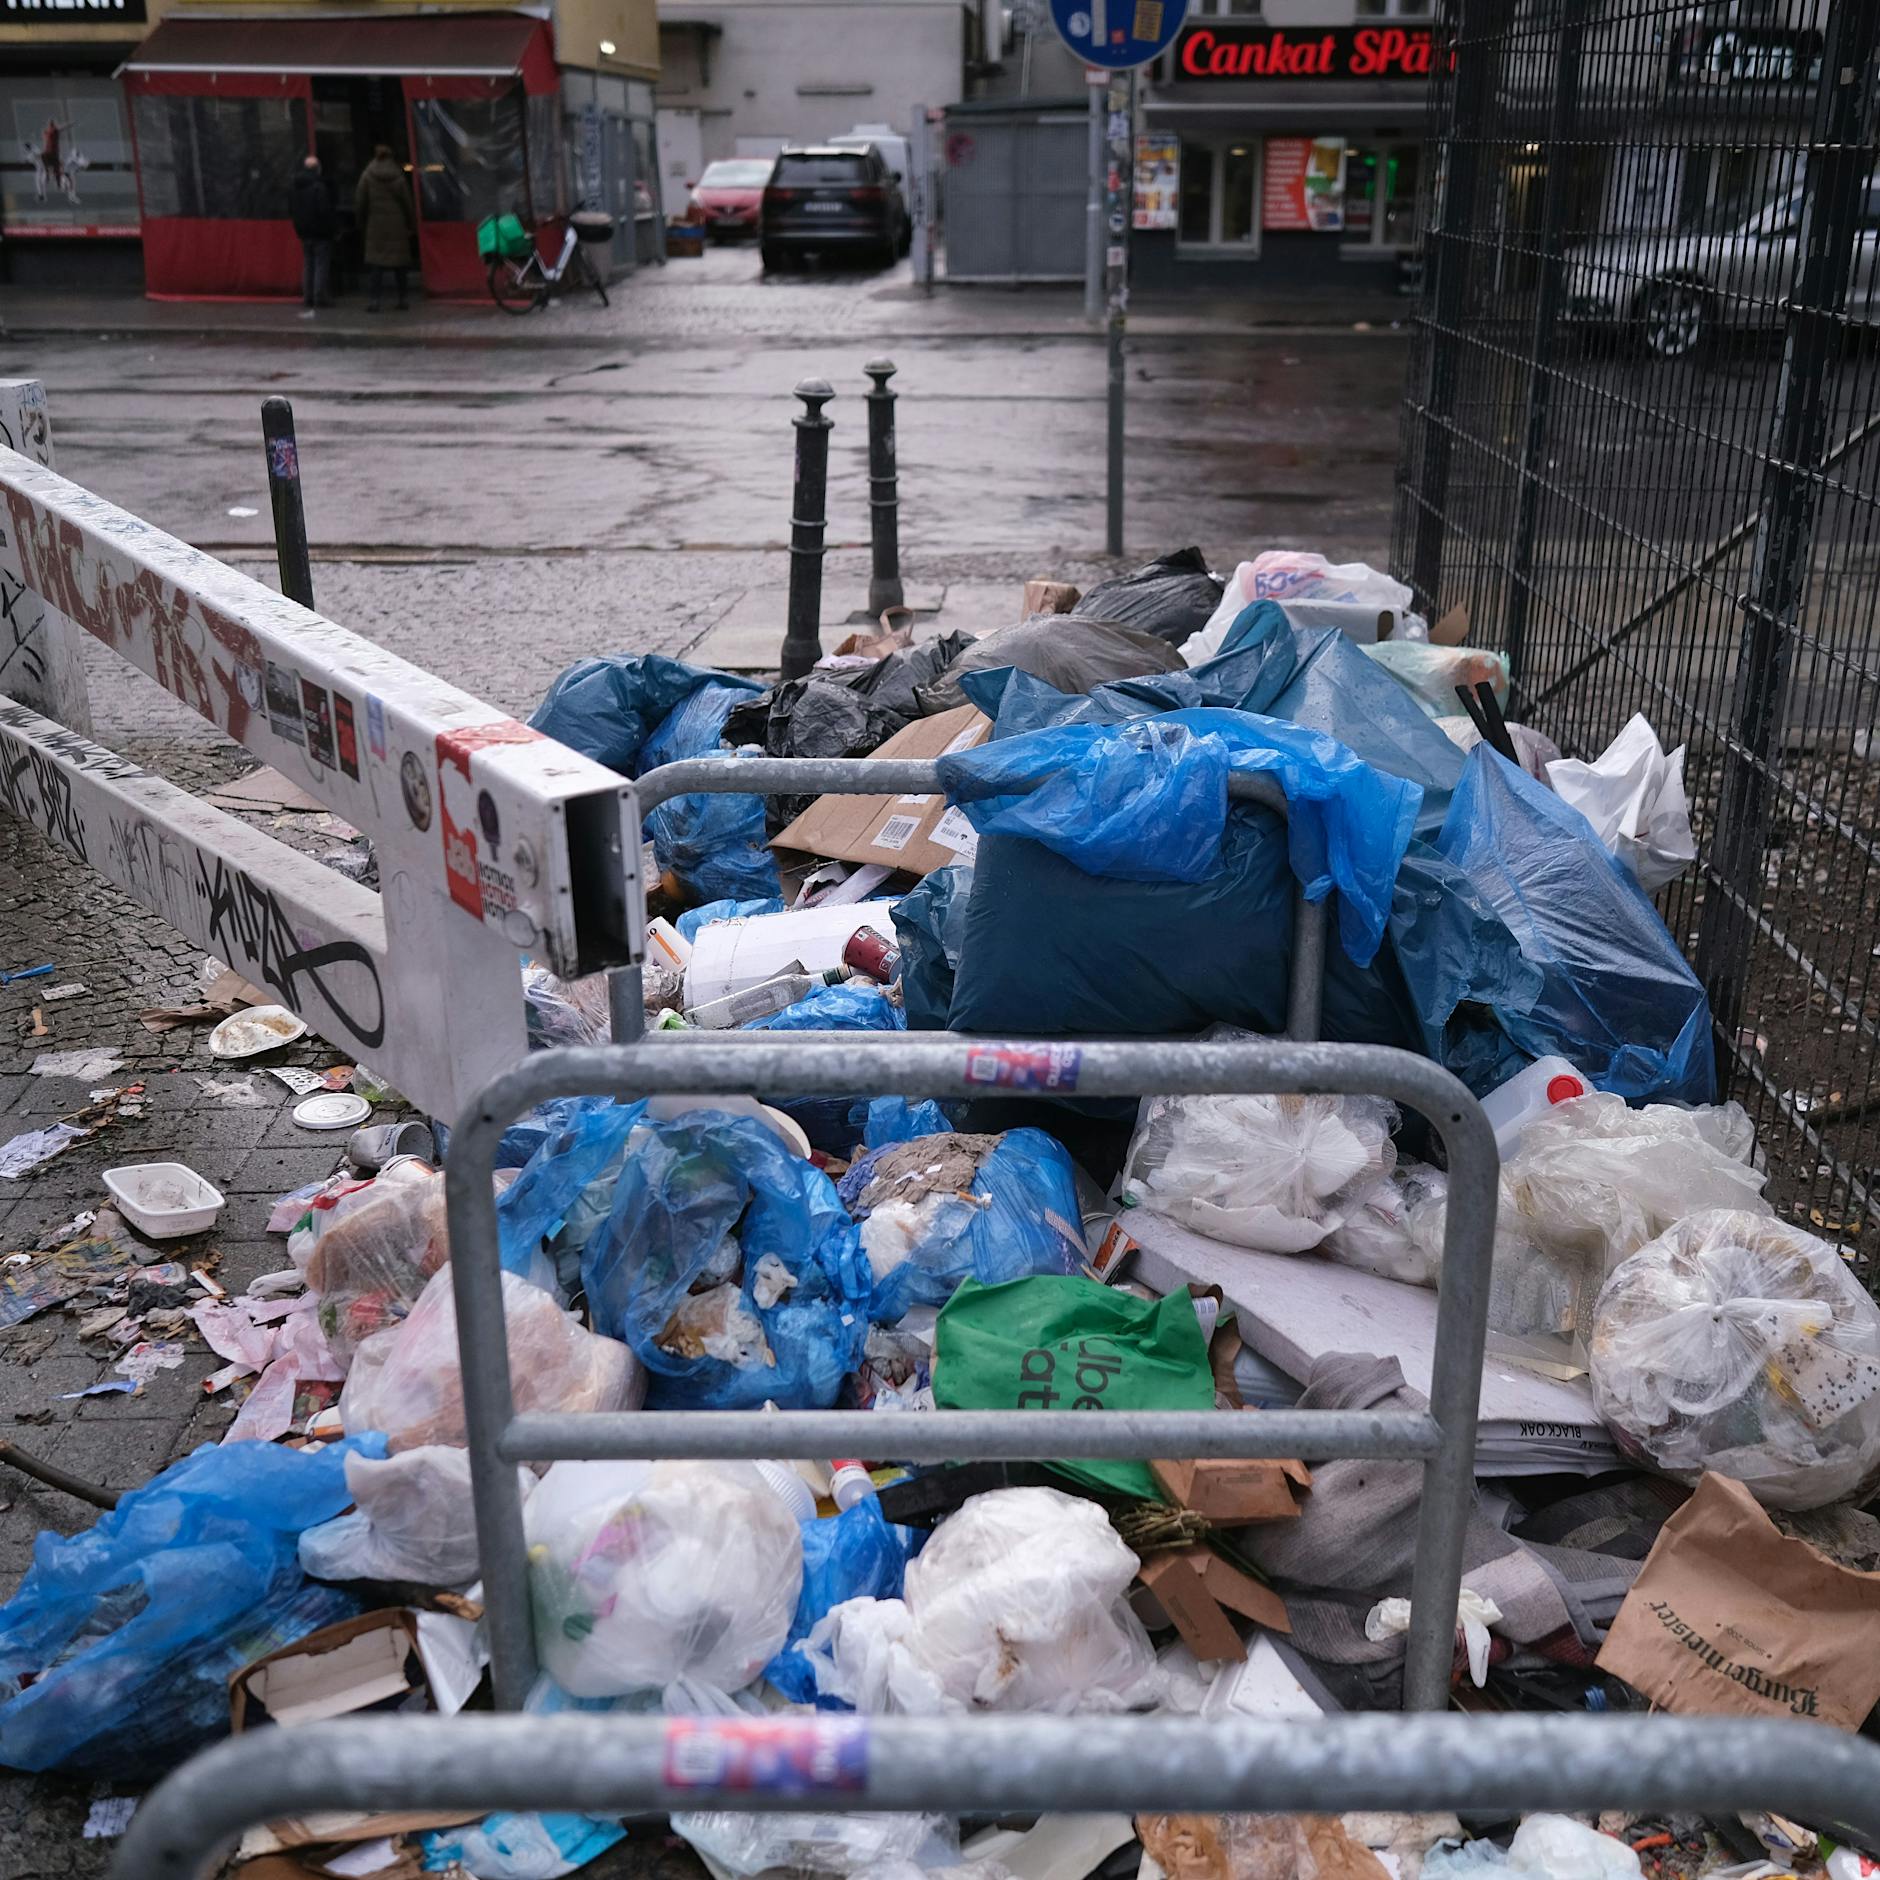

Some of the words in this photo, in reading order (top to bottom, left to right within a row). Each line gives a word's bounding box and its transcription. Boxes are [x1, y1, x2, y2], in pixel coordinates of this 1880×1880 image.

[1182, 29, 1336, 75] Cankat
[1349, 29, 1456, 75] SPä
[1520, 1422, 1546, 1437] OAK
[1548, 1423, 1582, 1438] BLACK
[1649, 1600, 1820, 1717] Burgermeister
